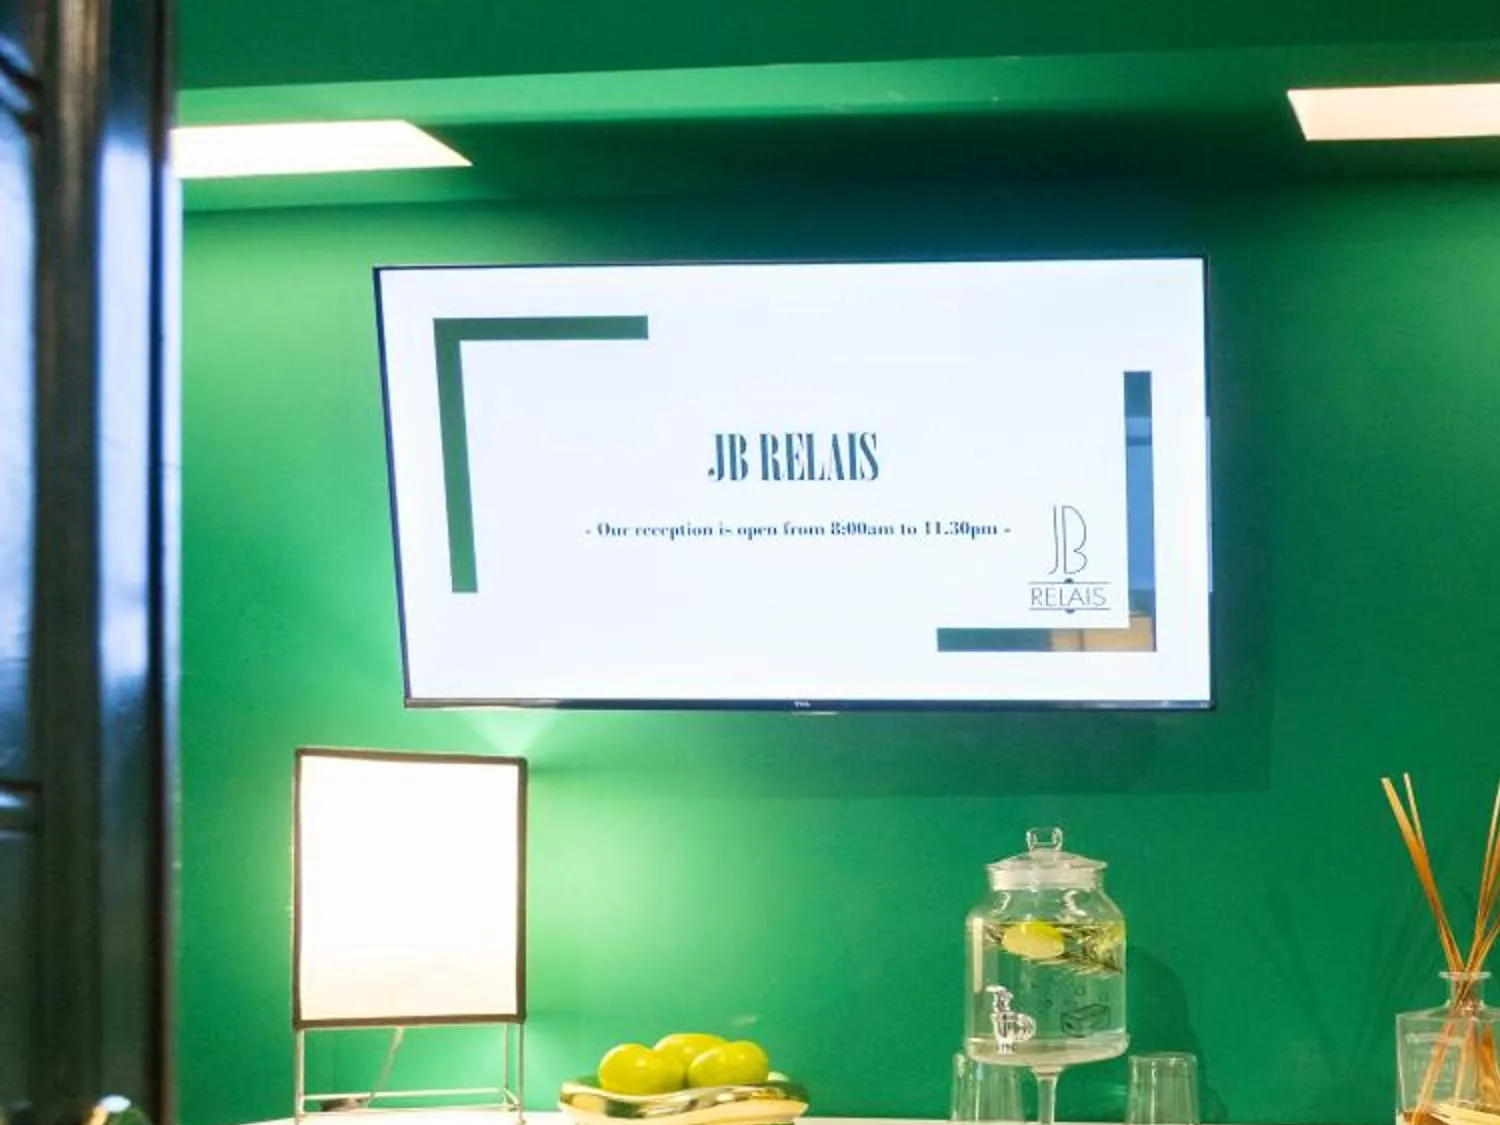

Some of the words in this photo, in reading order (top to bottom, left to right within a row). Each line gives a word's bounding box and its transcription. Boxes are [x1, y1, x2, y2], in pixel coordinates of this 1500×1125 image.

[707, 432, 750, 482] JB
[759, 431, 880, 482] RELAIS
[596, 521, 631, 537] Our
[634, 520, 713, 541] reception
[718, 520, 733, 537] is
[736, 525, 778, 541] open
[782, 520, 826, 537] from
[829, 520, 895, 537] 8:00am
[899, 522, 918, 537] to
[924, 519, 998, 541] 11.30pm
[1047, 504, 1088, 575] JB
[1030, 586, 1107, 607] RELAIS
